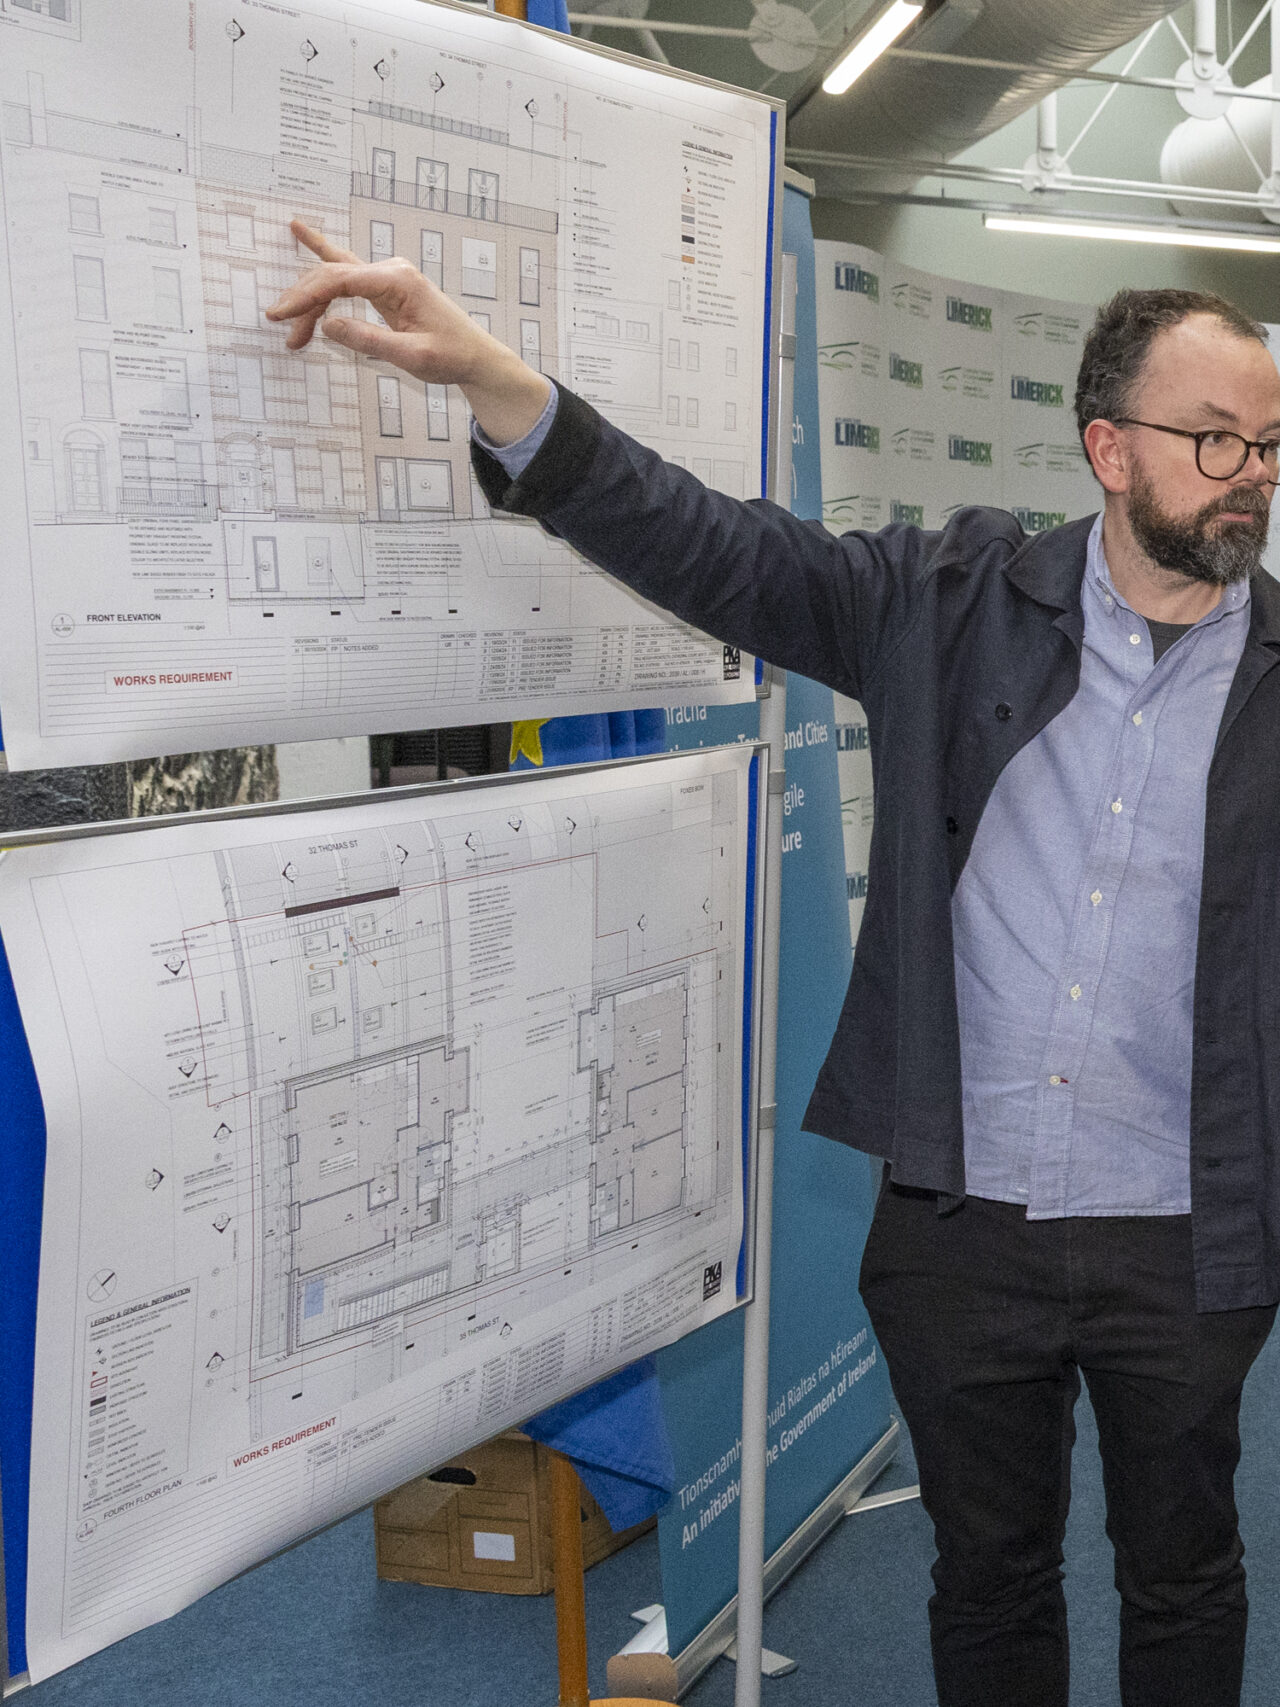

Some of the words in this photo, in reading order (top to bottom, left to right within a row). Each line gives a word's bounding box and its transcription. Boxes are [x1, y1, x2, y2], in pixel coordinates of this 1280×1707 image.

[946, 299, 992, 329] LIMERICK
[1011, 378, 1063, 404] LIMERICK
[949, 438, 992, 463] LIMERICK
[87, 614, 115, 623] FRONT
[117, 613, 161, 622] ELEVATION
[113, 675, 156, 686] WORKS
[159, 671, 233, 685] REQUIREMENT
[805, 722, 829, 747] Cities
[308, 845, 317, 855] 32
[317, 841, 350, 853] THOMAS
[350, 839, 359, 849] ST
[467, 1322, 491, 1336] THOMAS
[491, 1316, 500, 1326] ST
[787, 1372, 817, 1410] Rialtas
[818, 1361, 830, 1382] na
[831, 1327, 867, 1370] hÉireann
[233, 1446, 269, 1467] WORKS
[271, 1417, 336, 1452] REQUIREMENT
[682, 1521, 698, 1549] An
[700, 1479, 741, 1530] initiativ
[780, 1388, 836, 1452] Government
[837, 1379, 848, 1397] of
[848, 1345, 877, 1388] Ireland
[103, 1501, 135, 1519] FOURTH
[135, 1489, 161, 1505] FLOOR
[162, 1478, 182, 1493] PLAN
